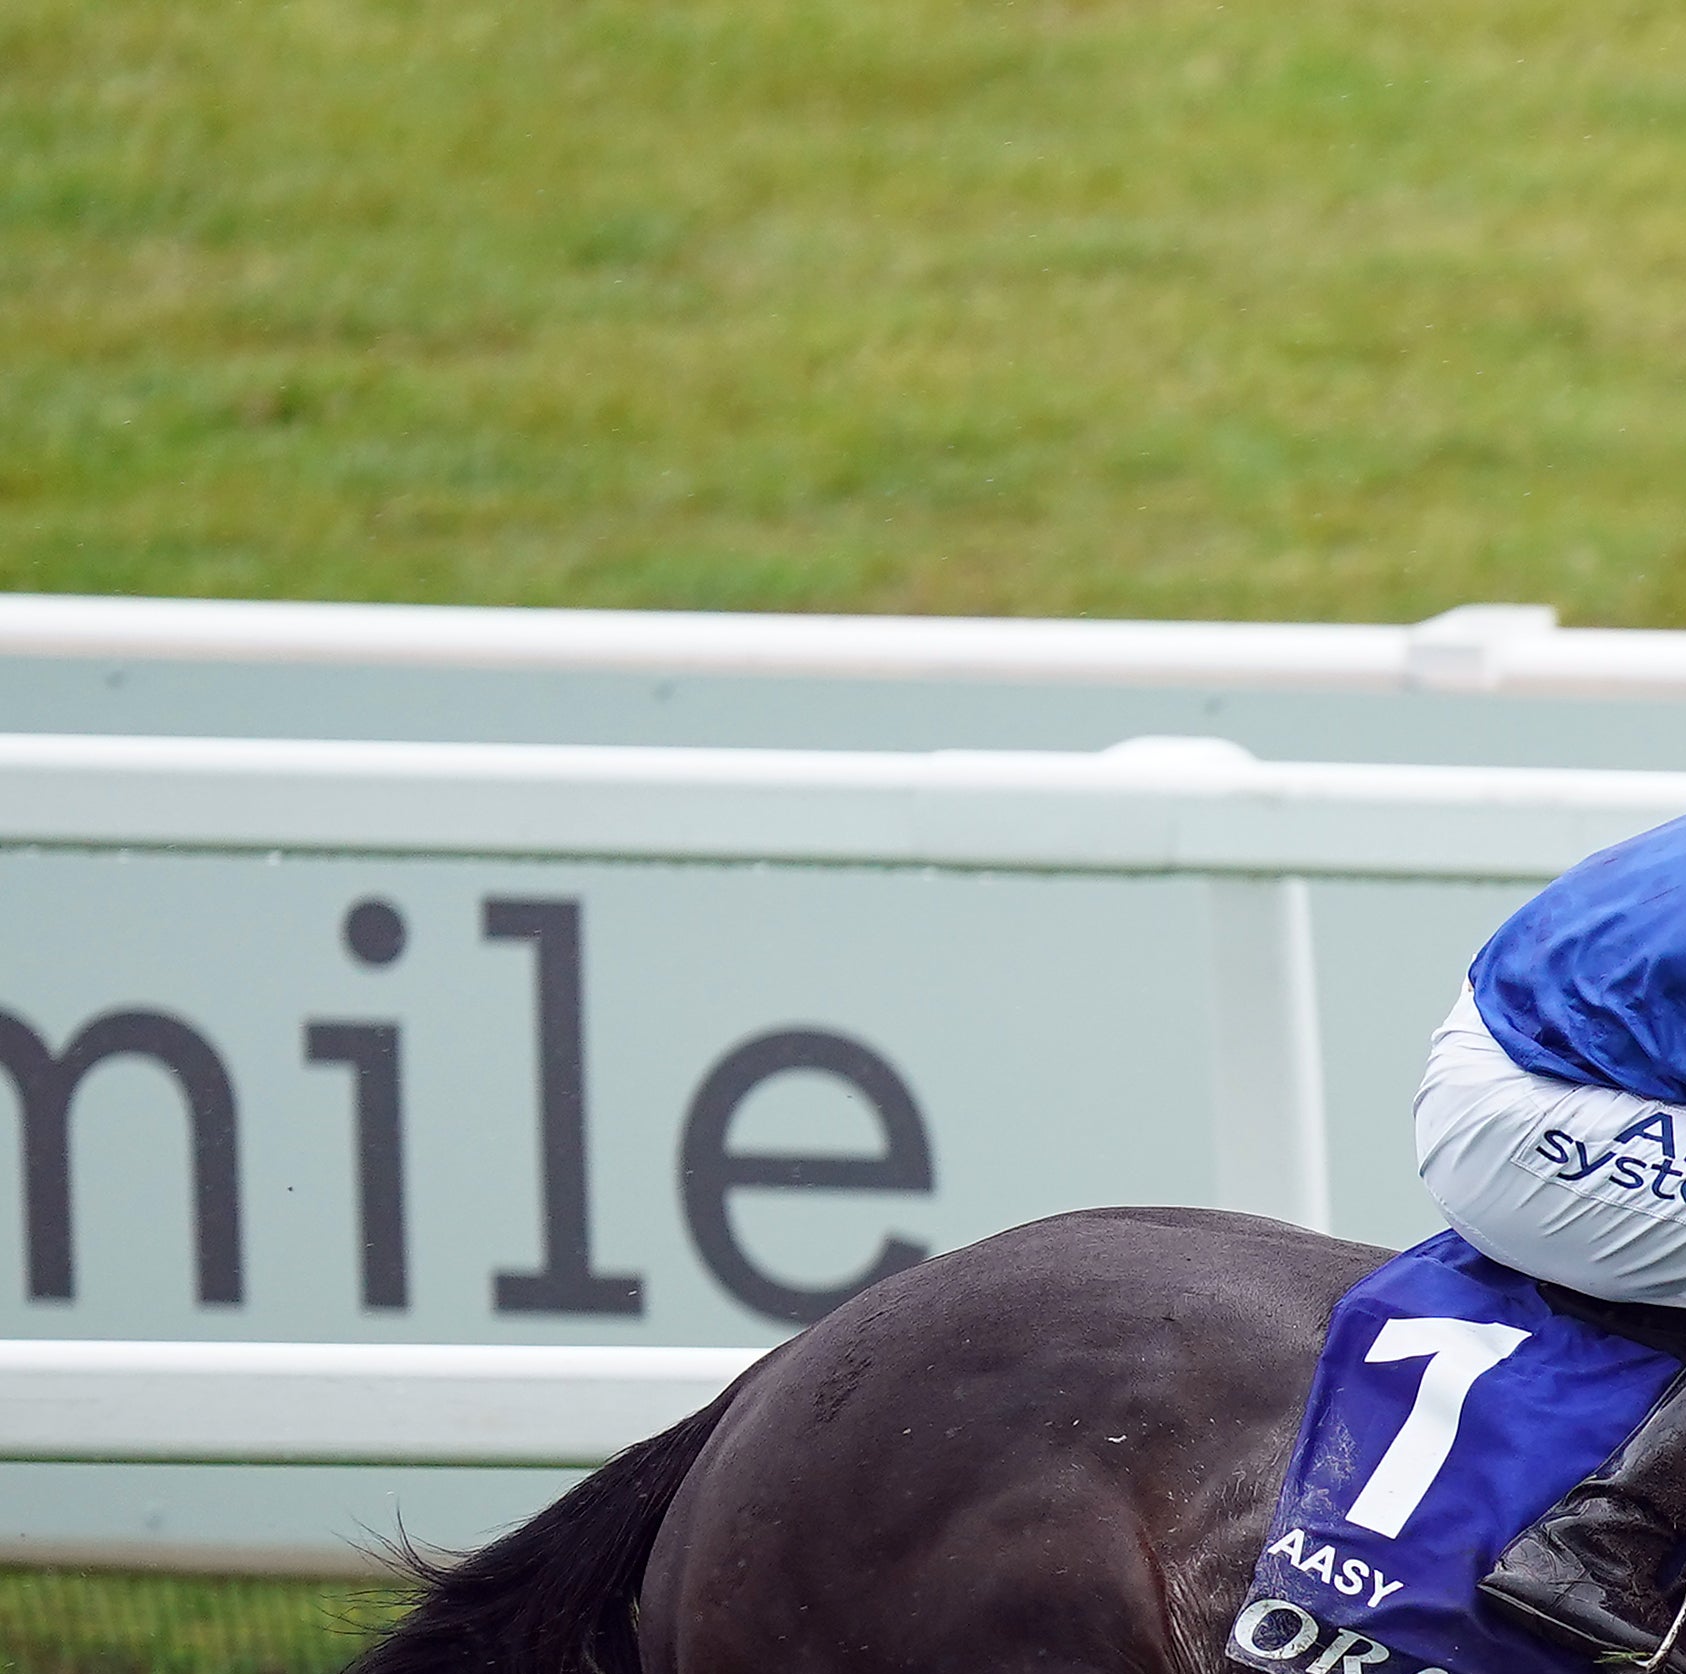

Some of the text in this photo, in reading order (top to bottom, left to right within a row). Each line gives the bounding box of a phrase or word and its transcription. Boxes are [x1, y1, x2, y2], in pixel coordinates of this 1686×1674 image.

[0, 892, 936, 1324] mile
[1344, 1317, 1533, 1540] 7
[1267, 1527, 1404, 1609] AASY
